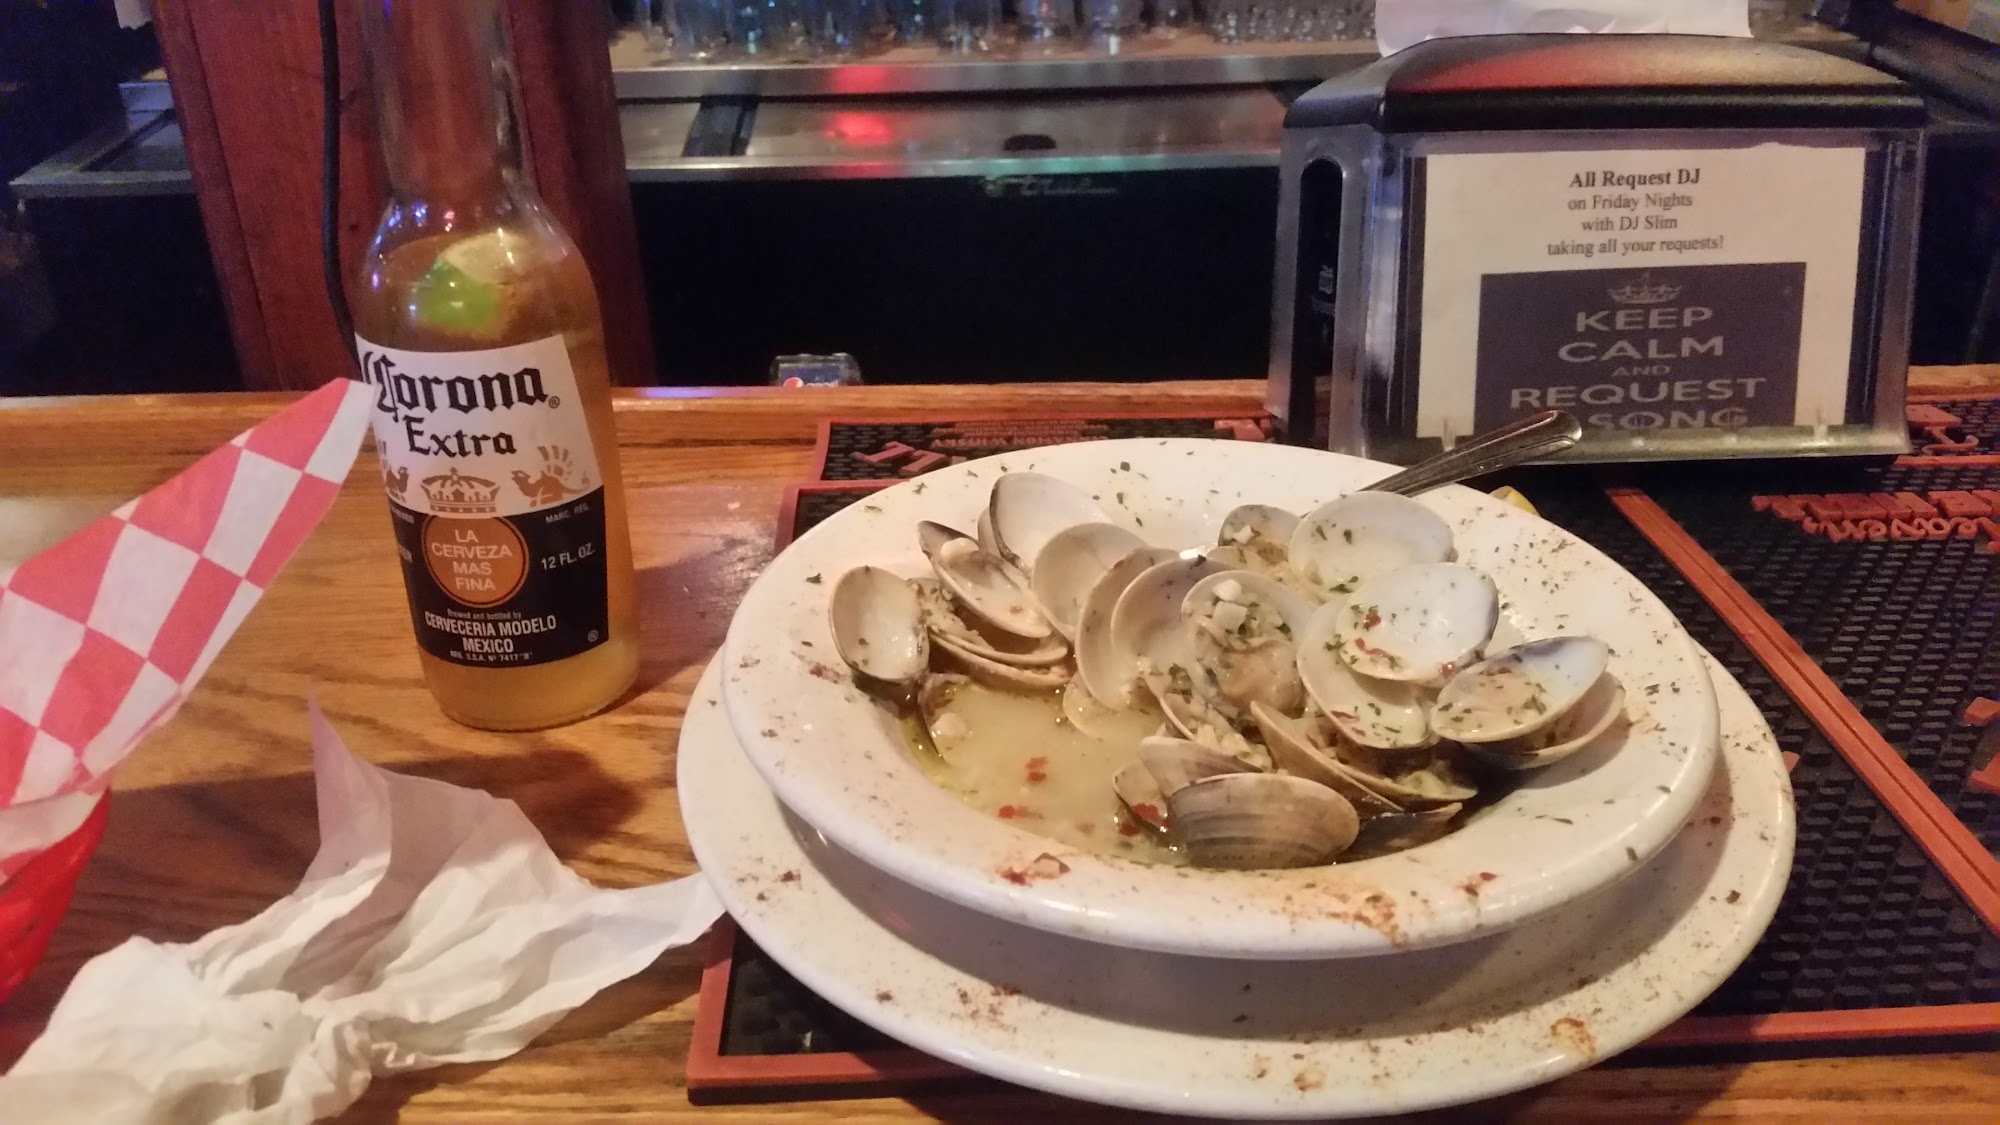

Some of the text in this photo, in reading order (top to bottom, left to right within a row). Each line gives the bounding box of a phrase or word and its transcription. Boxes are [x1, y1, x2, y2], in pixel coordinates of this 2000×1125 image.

[1569, 168, 1701, 190] All Request DJ
[1568, 193, 1693, 211] on Friday Nights
[1581, 214, 1678, 232] with DJ Slim
[1548, 234, 1725, 257] taking all your requests!
[1576, 306, 1713, 333] KEEP
[1558, 335, 1724, 363] CALM
[1611, 365, 1671, 377] AND
[363, 351, 549, 423] Corona
[1510, 377, 1767, 409] REQUEST
[1588, 406, 1749, 430] SONG
[402, 415, 518, 458] Extra
[455, 529, 479, 543] LA
[431, 542, 513, 559] CERVEZA
[453, 561, 492, 575] MAS
[541, 555, 557, 570] 12
[455, 577, 496, 591] FINA
[424, 610, 557, 637] CERVECERIA MODELO
[462, 637, 515, 653] MEXICO
